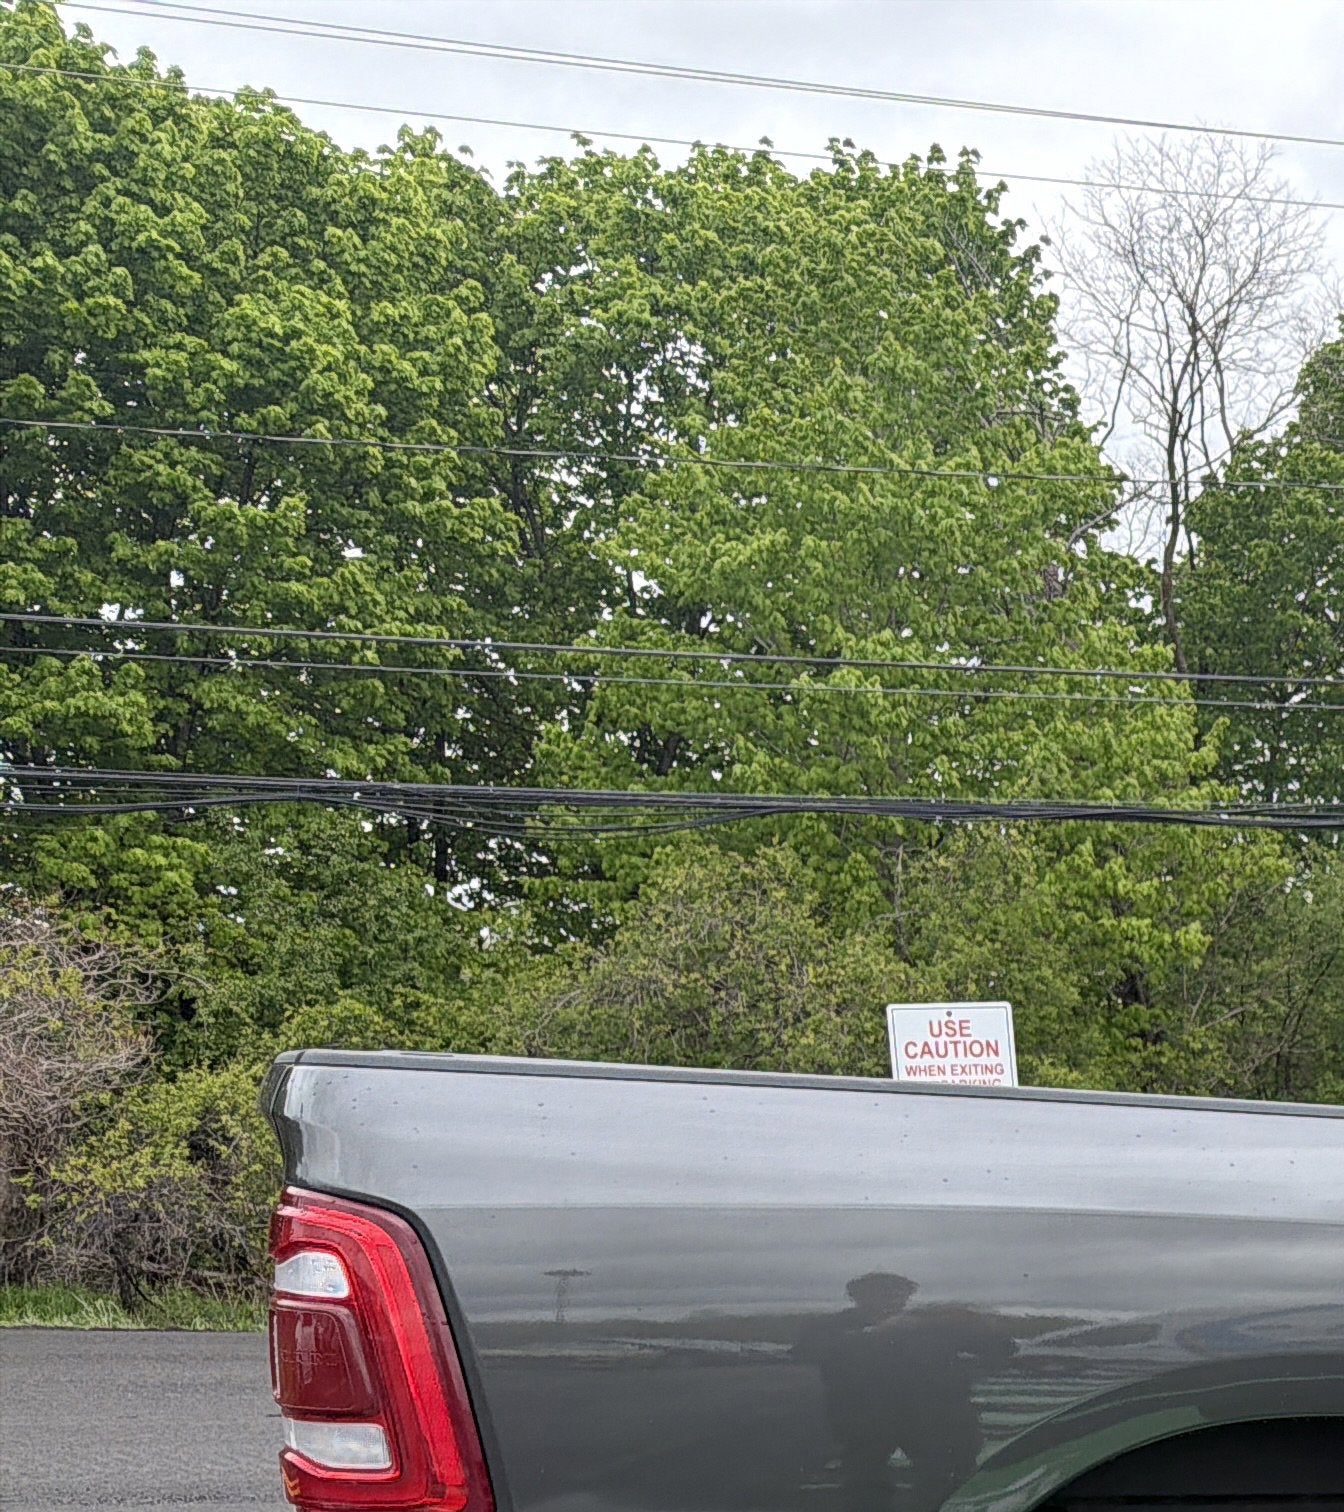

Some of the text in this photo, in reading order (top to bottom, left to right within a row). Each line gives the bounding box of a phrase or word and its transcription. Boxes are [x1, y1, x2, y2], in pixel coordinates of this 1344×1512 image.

[929, 1019, 972, 1038] USE
[904, 1039, 1000, 1060] CAUTION
[905, 1062, 1005, 1077] WHEN EXITING
